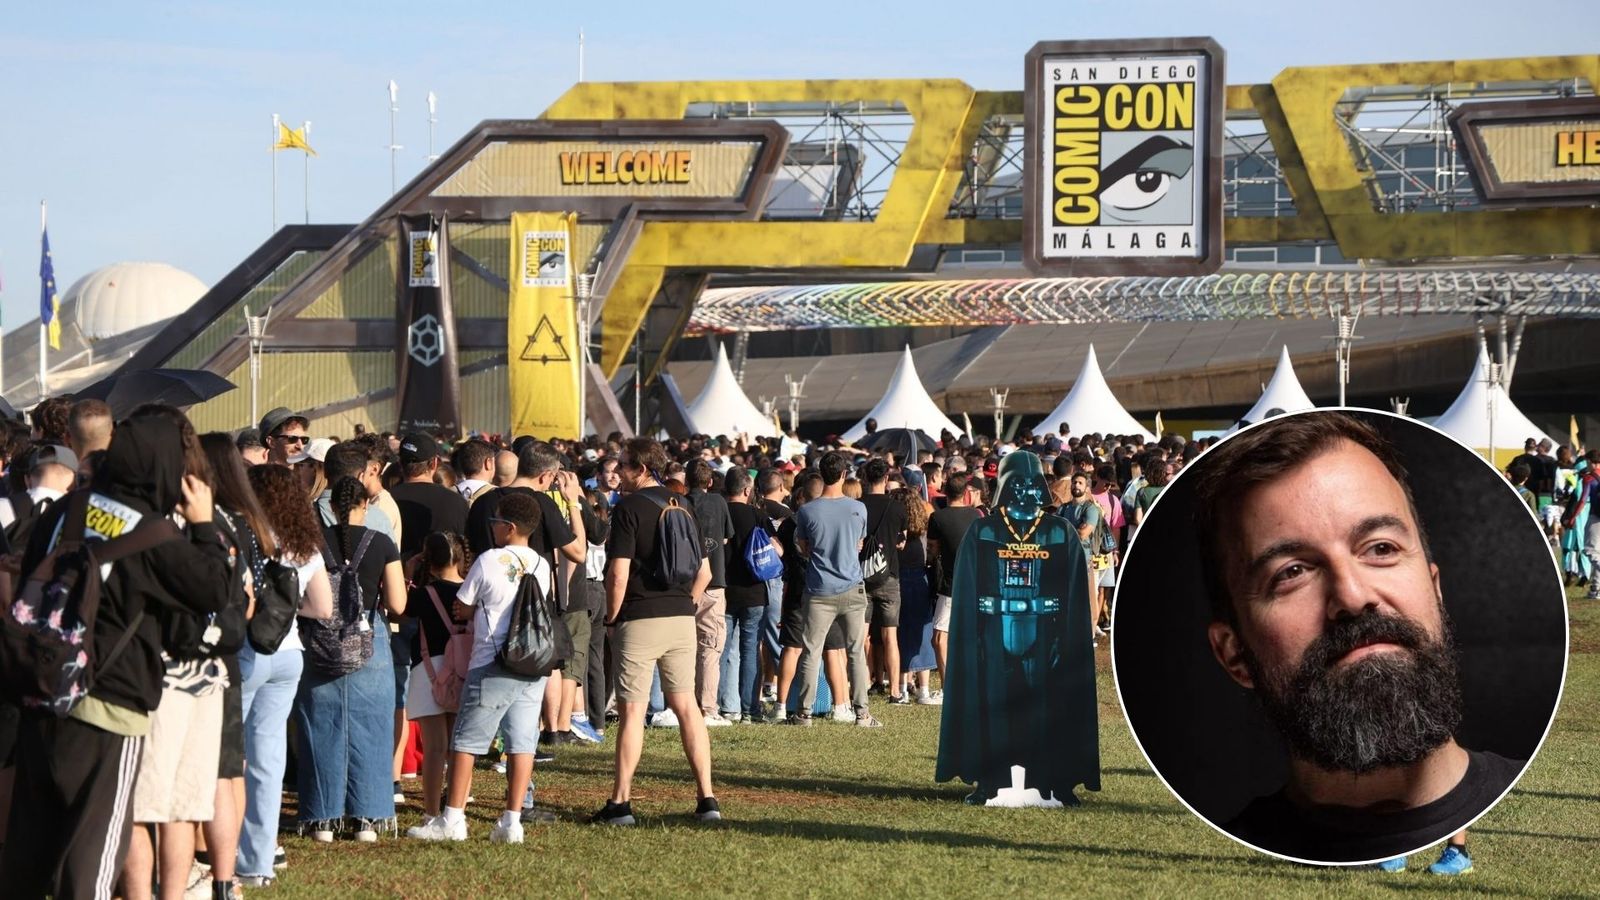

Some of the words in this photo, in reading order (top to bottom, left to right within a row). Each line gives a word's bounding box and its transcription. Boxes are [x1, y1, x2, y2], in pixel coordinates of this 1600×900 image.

[1053, 67, 1097, 81] SAN
[1119, 65, 1195, 79] DIEGO
[1104, 83, 1194, 130] CON
[560, 150, 691, 185] WELCOME
[1055, 85, 1101, 225] COMIC
[541, 239, 565, 251] CON
[1053, 229, 1191, 249] MÁLAGA
[527, 238, 540, 277] COMIC
